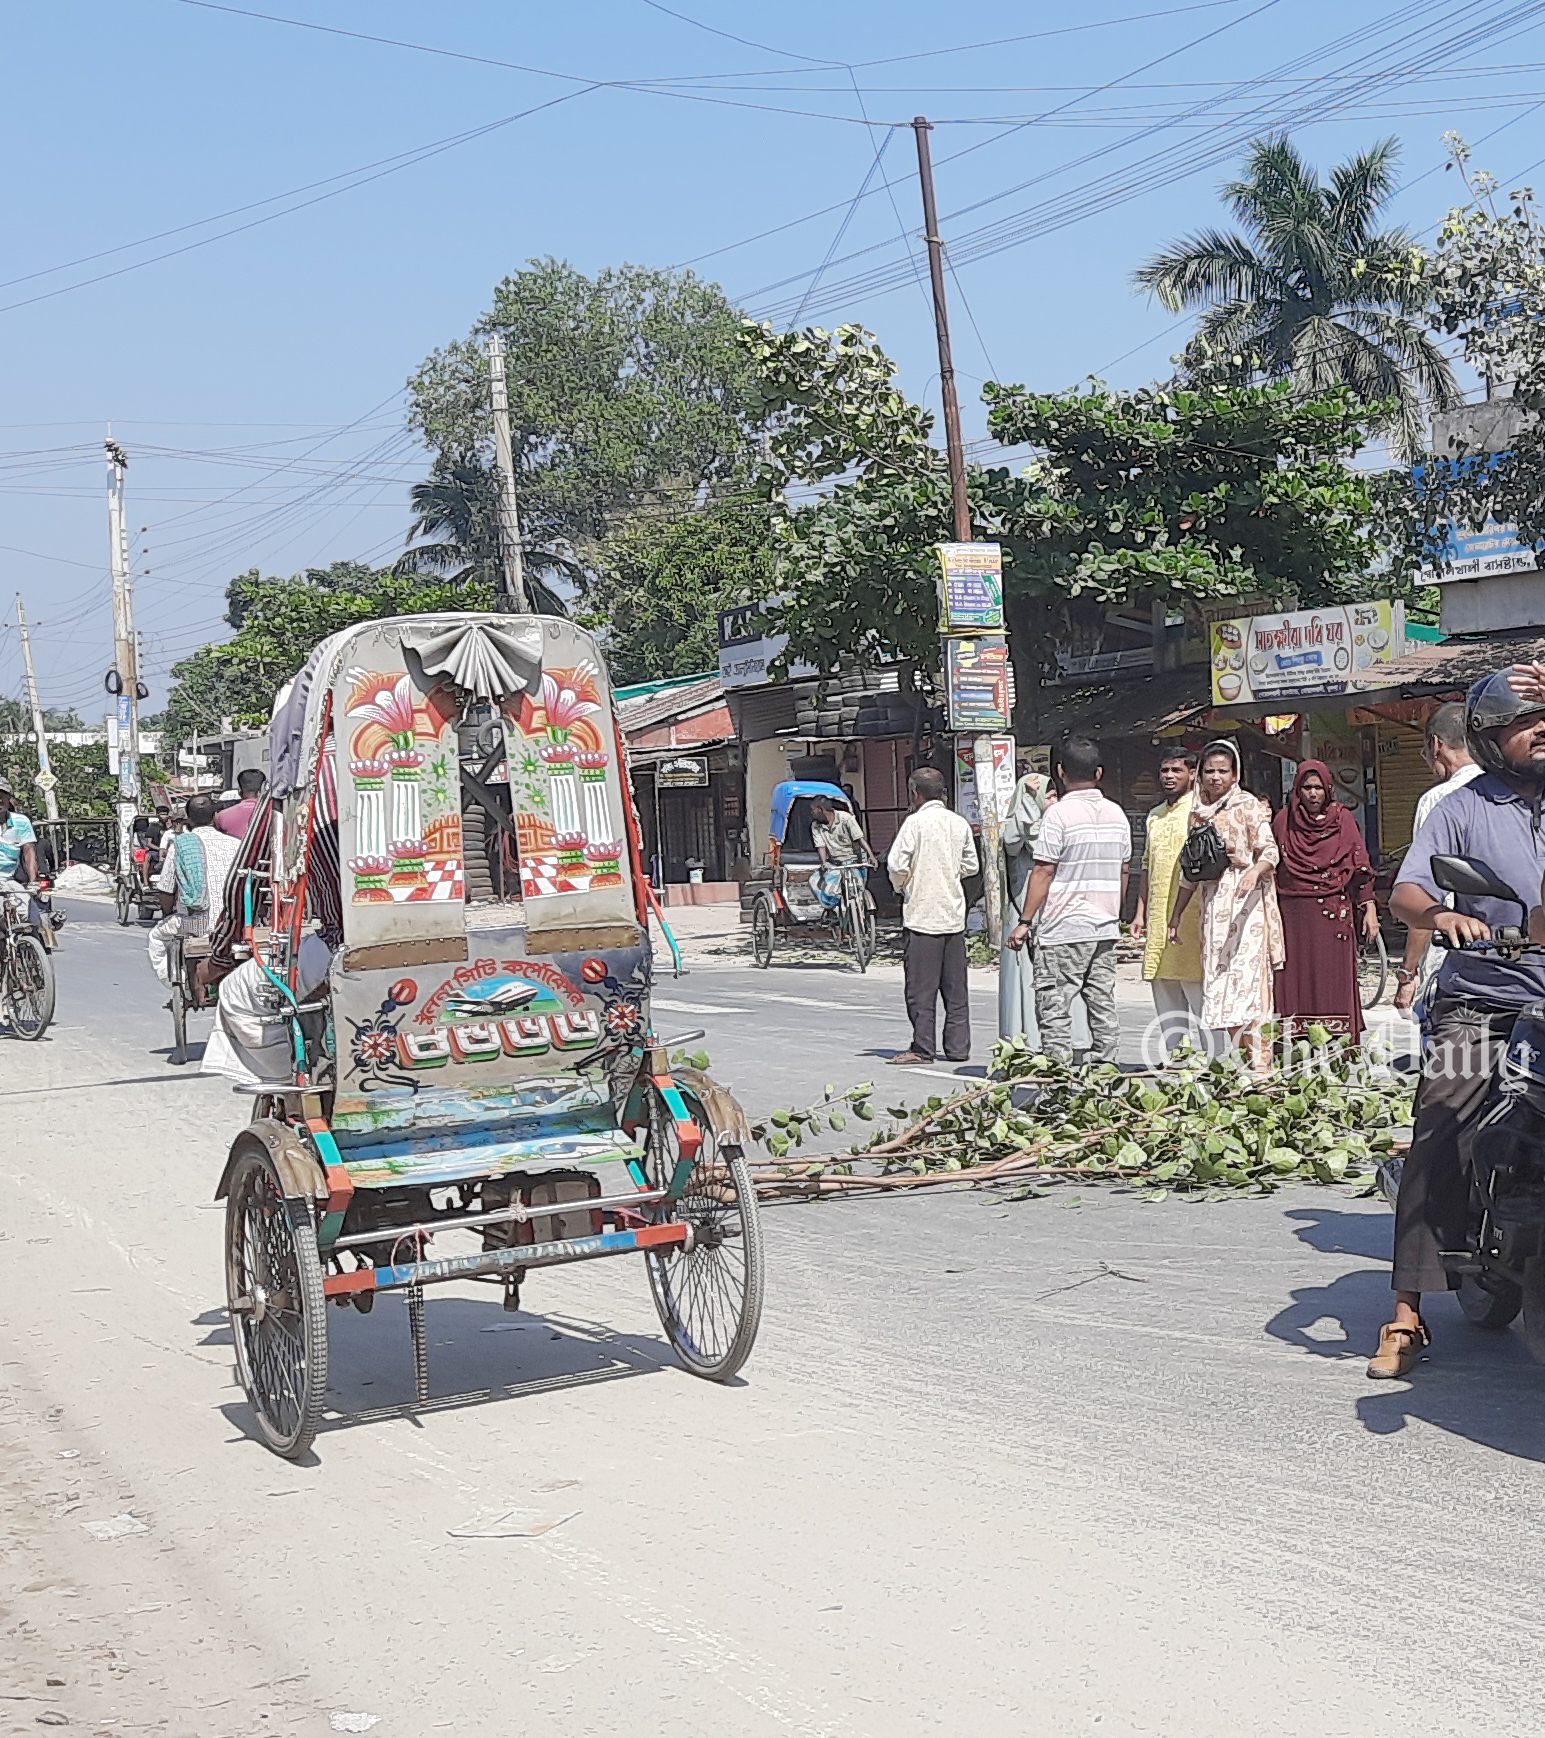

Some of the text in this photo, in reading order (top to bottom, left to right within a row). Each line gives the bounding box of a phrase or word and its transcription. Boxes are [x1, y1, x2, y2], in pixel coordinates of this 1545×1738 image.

[1255, 620, 1302, 651] সাতক্ষীরা
[1326, 622, 1345, 644] ঘর
[453, 958, 497, 986] সিটি
